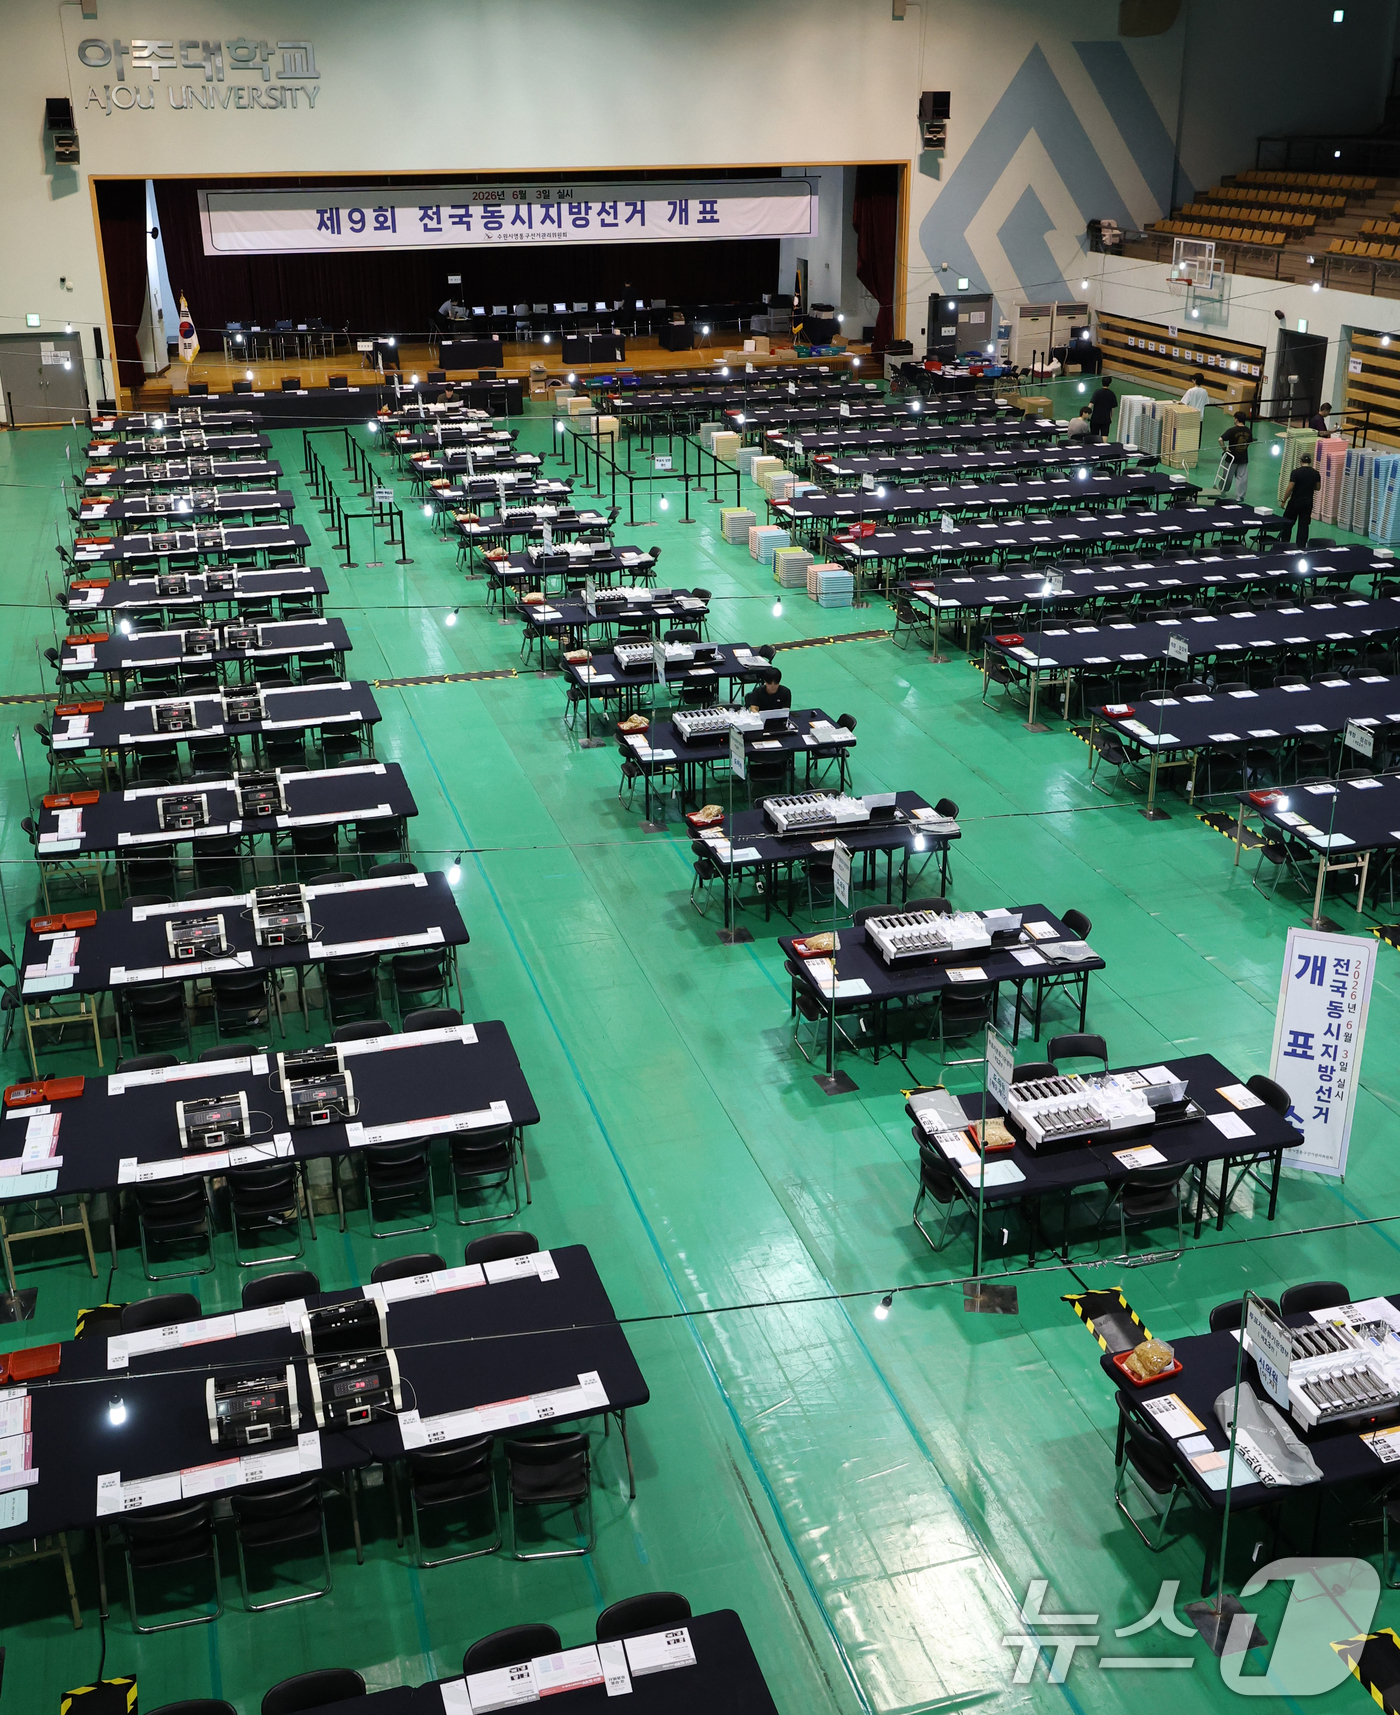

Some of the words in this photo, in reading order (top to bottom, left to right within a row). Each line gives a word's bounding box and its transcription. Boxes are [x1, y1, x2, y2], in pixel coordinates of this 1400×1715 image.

[78, 37, 321, 83] 아주대학교
[85, 85, 156, 117] AJOU
[168, 85, 321, 110] UNIVERSITY
[472, 190, 506, 201] 2026년
[511, 190, 527, 201] 6월
[535, 189, 551, 200] 3일
[556, 188, 574, 199] 실시
[315, 206, 397, 235] 제9회
[418, 199, 647, 234] 전국동시지방선거
[667, 198, 721, 226] 개표
[497, 231, 568, 241] 수원시영통구선거관리위원회
[1347, 959, 1362, 1014] 2026년
[1312, 957, 1351, 1124] 전국동시지방선거
[1343, 1020, 1353, 1044] 6월
[1339, 1049, 1349, 1073] 3일
[1334, 1077, 1347, 1102] 실시
[1249, 1311, 1289, 1358] 투표지분류기운영부
[1259, 1357, 1279, 1384] 시의원
